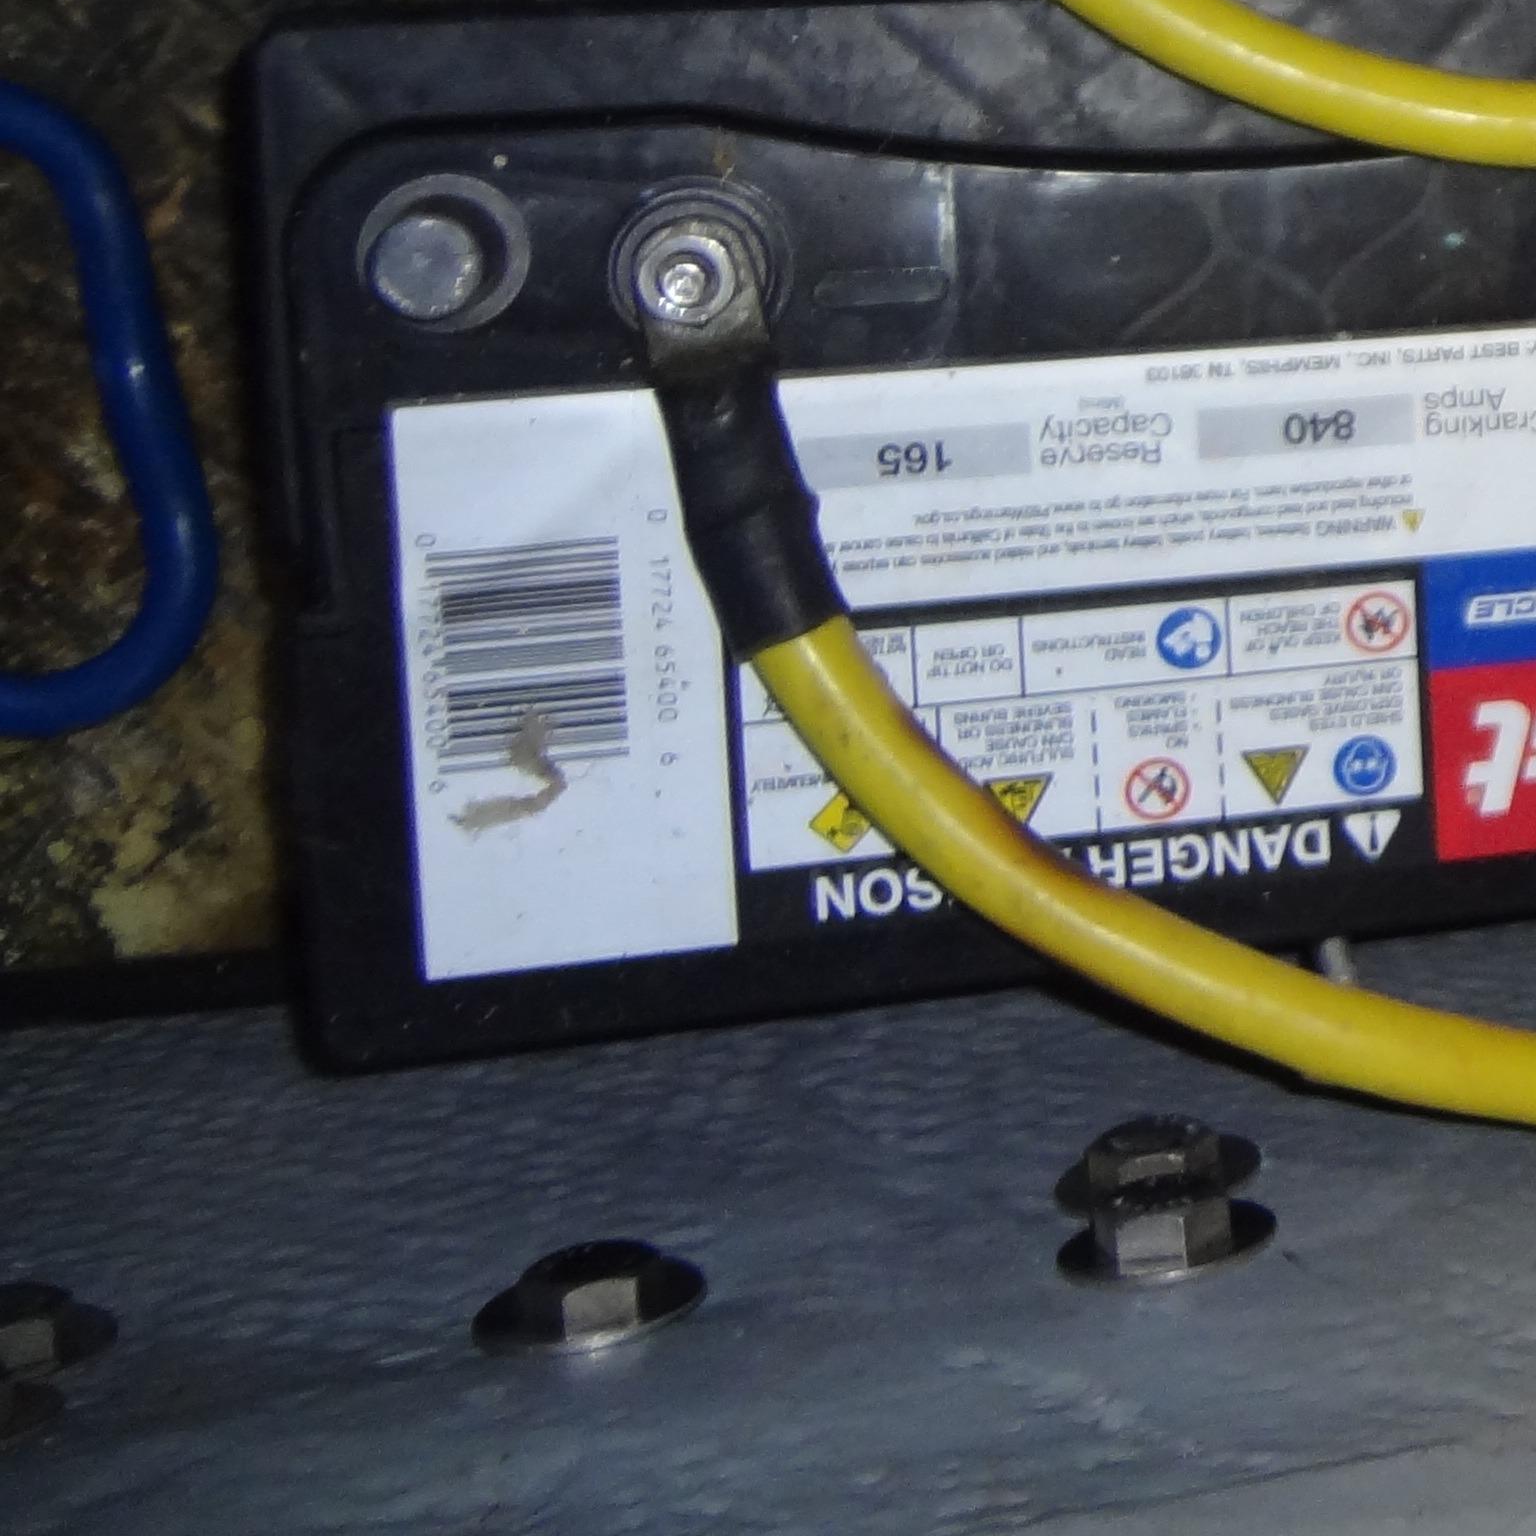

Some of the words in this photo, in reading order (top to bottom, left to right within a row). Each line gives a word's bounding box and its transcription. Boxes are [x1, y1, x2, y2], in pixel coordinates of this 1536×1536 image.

[1471, 339, 1519, 358] BEST
[1423, 381, 1506, 415] Amps
[1037, 405, 1172, 447] Capacity
[1281, 407, 1357, 446] 840
[875, 437, 953, 478] 165
[1039, 438, 1161, 473] Reserve
[1087, 817, 1331, 891] DANGER
